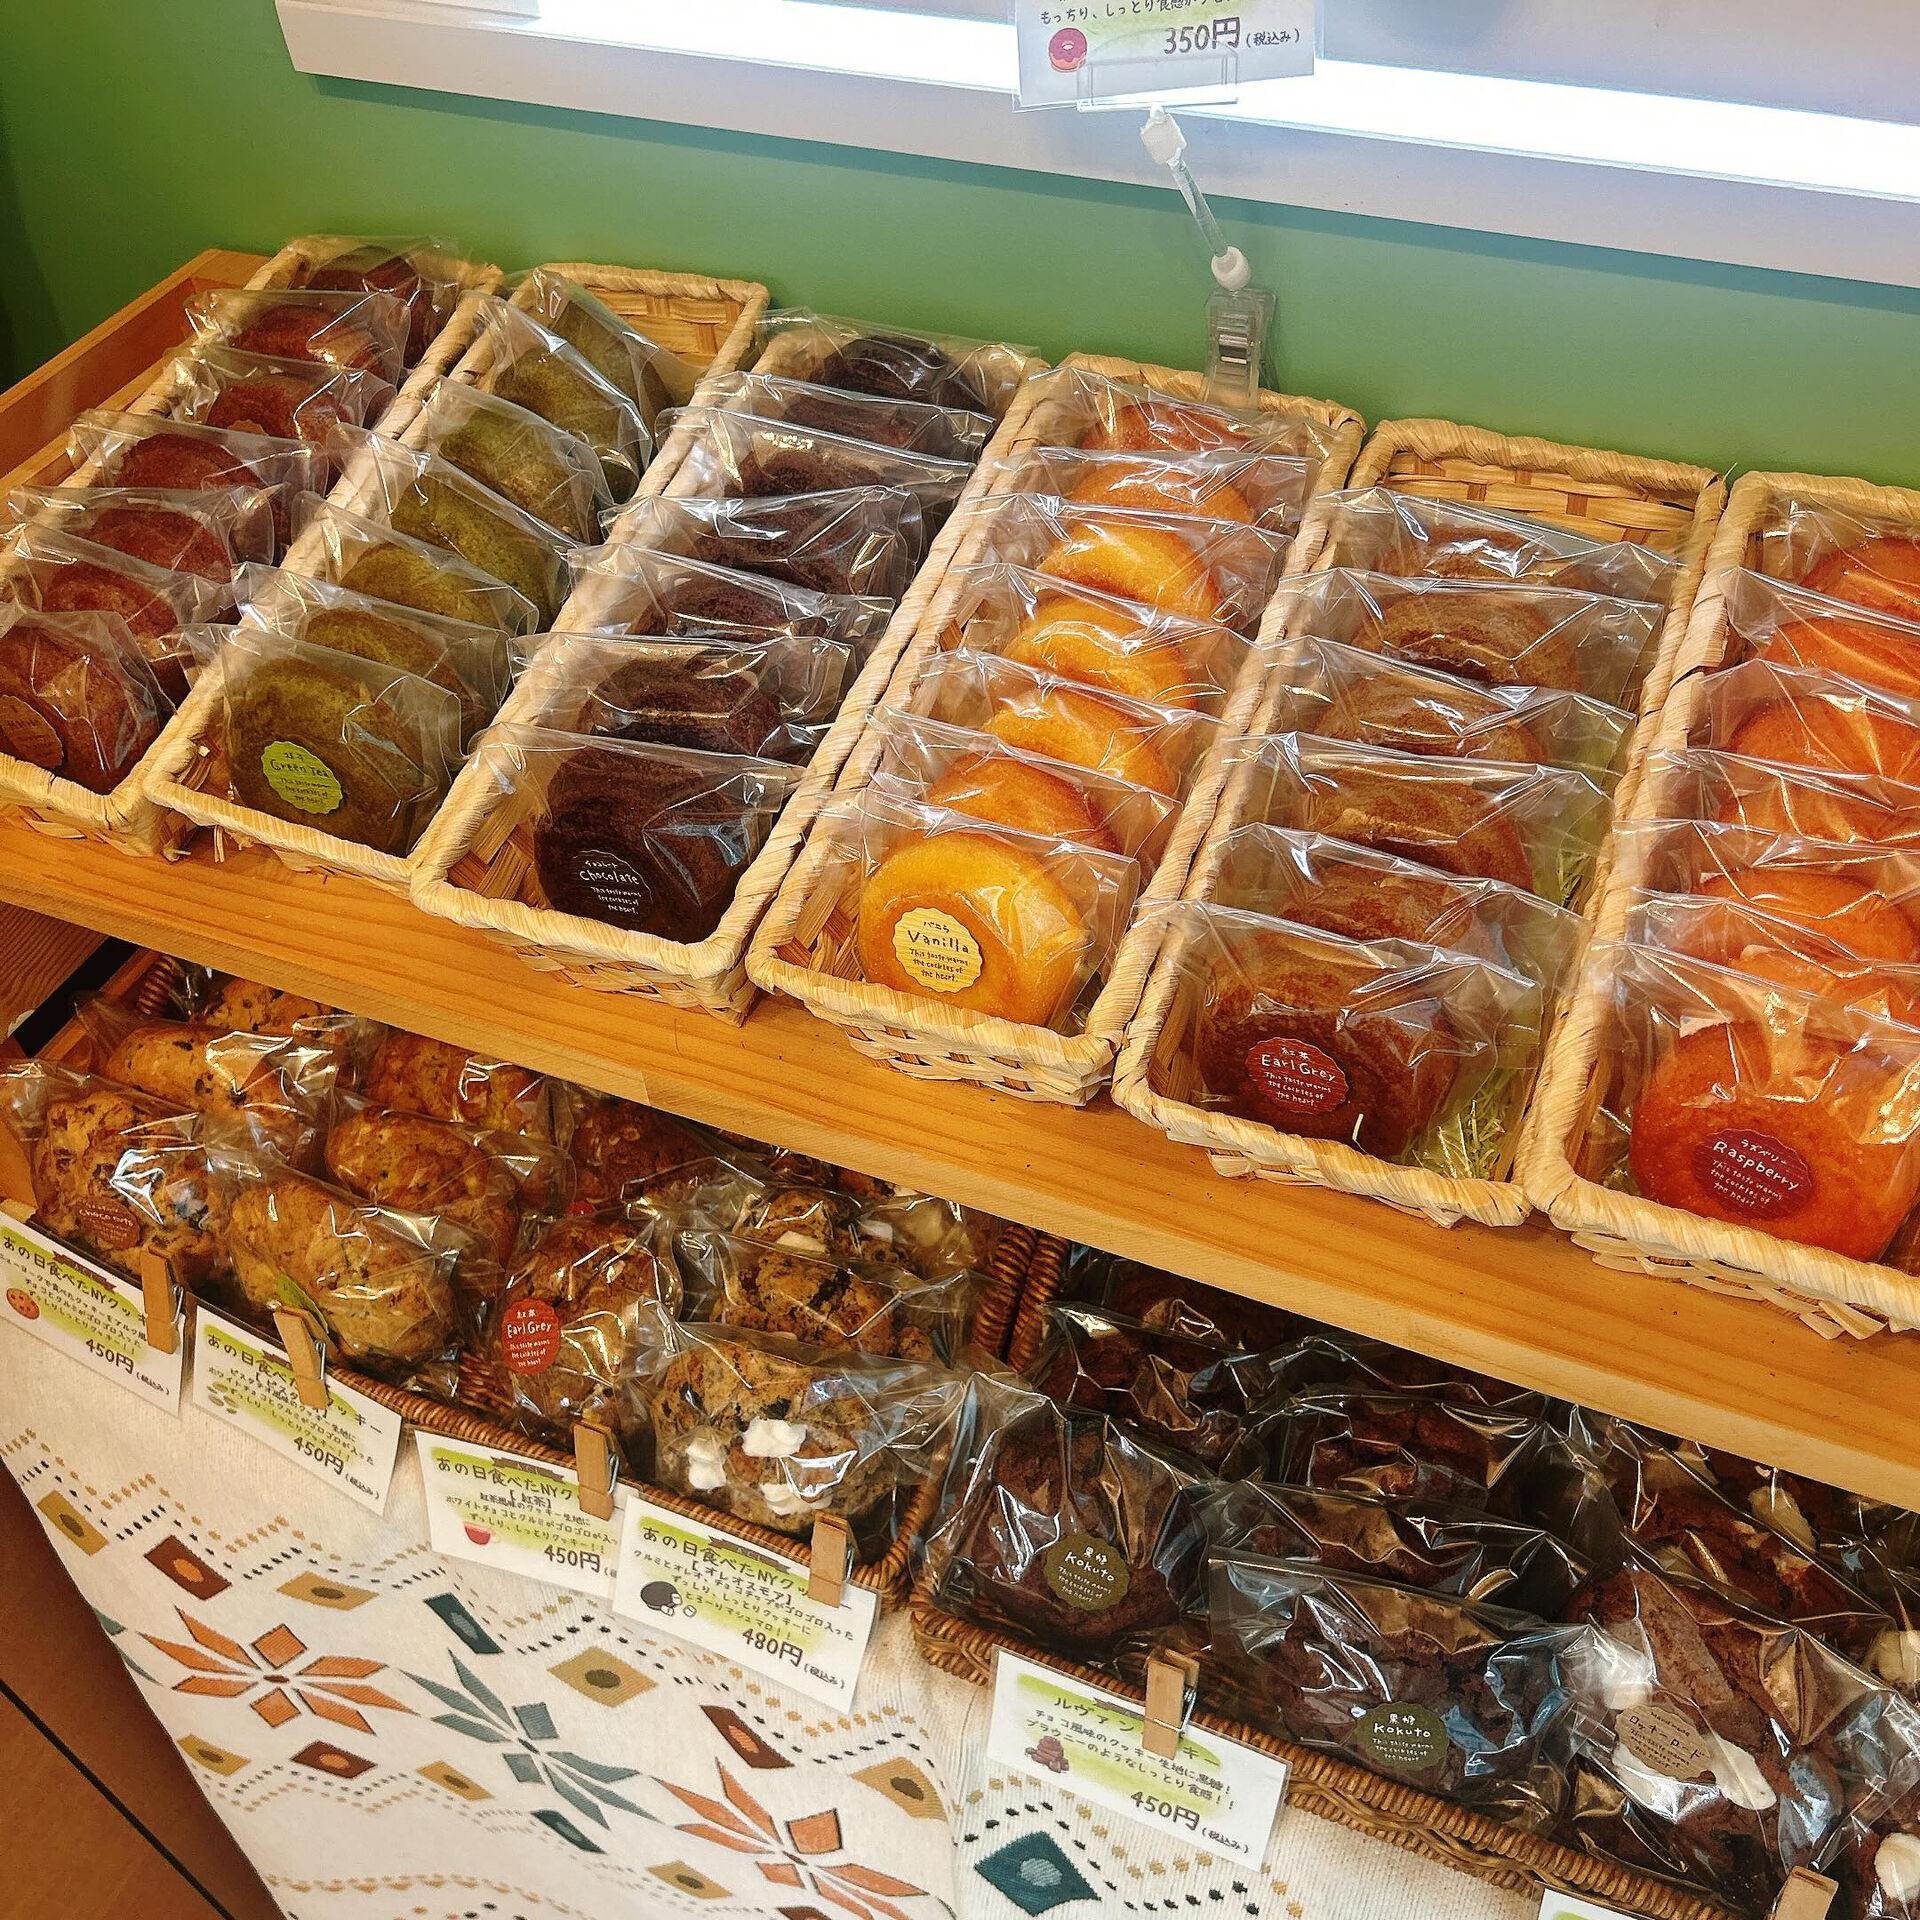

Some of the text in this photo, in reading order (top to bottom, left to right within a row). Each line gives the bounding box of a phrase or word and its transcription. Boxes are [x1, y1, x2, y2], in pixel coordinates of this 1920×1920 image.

[1164, 16, 1241, 55] 350円
[580, 870, 639, 885] Chocolate
[907, 929, 969, 953] Vanilla
[923, 921, 950, 933] バニラ
[1261, 1054, 1335, 1081] Earl Grey
[1713, 1141, 1799, 1191] Raspberry
[1741, 1138, 1787, 1165] ラズベリー
[507, 1321, 552, 1339] Earl Grey
[86, 1339, 135, 1375] 450円
[293, 1436, 345, 1476] 450円
[544, 1544, 601, 1574] 450円
[1064, 1551, 1115, 1582] Kokuto
[741, 1627, 803, 1668] 480円
[1373, 1722, 1431, 1738] Kokuto
[1629, 1715, 1705, 1759] ロッキーロード
[1130, 1790, 1201, 1832] 450円
